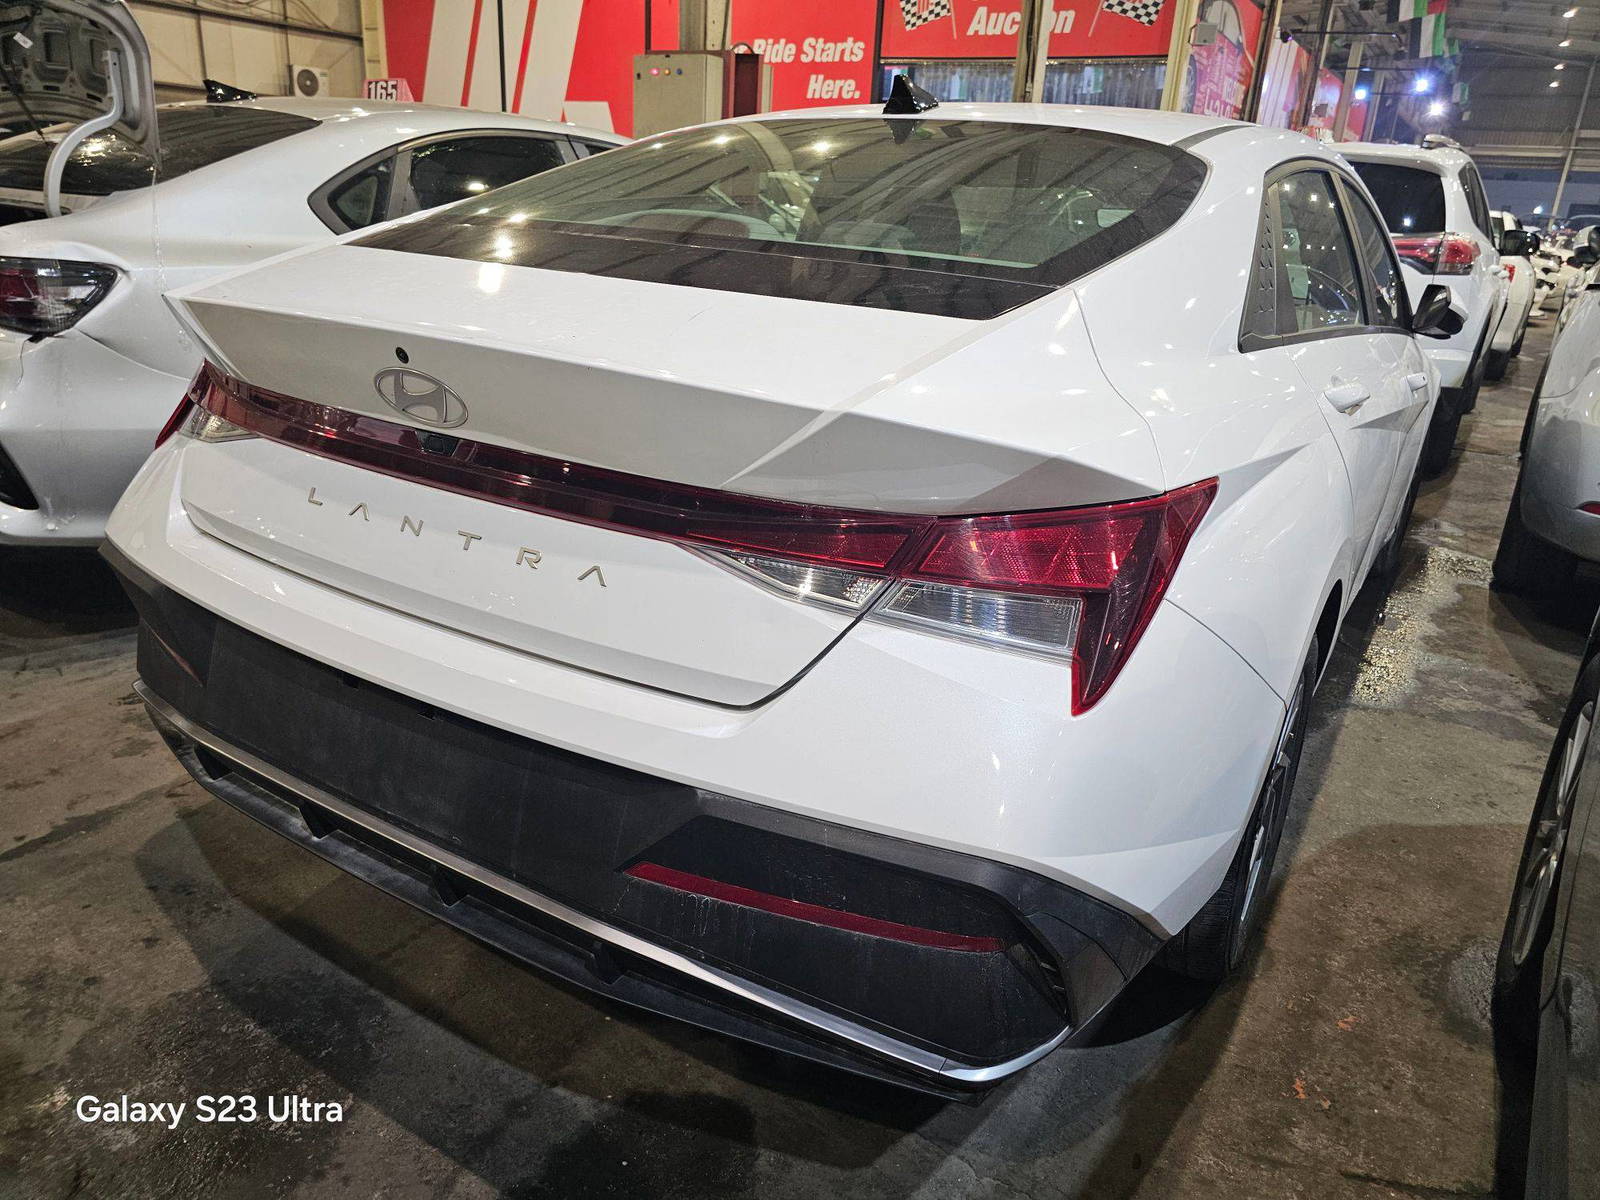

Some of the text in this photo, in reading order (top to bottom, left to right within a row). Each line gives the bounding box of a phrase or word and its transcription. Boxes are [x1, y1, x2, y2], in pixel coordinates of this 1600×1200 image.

[966, 6, 1076, 36] Aucn
[752, 38, 797, 63] Ride
[800, 37, 865, 63] Starts
[368, 80, 398, 101] 165
[806, 74, 861, 99] Here.
[307, 486, 607, 588] LANTRA
